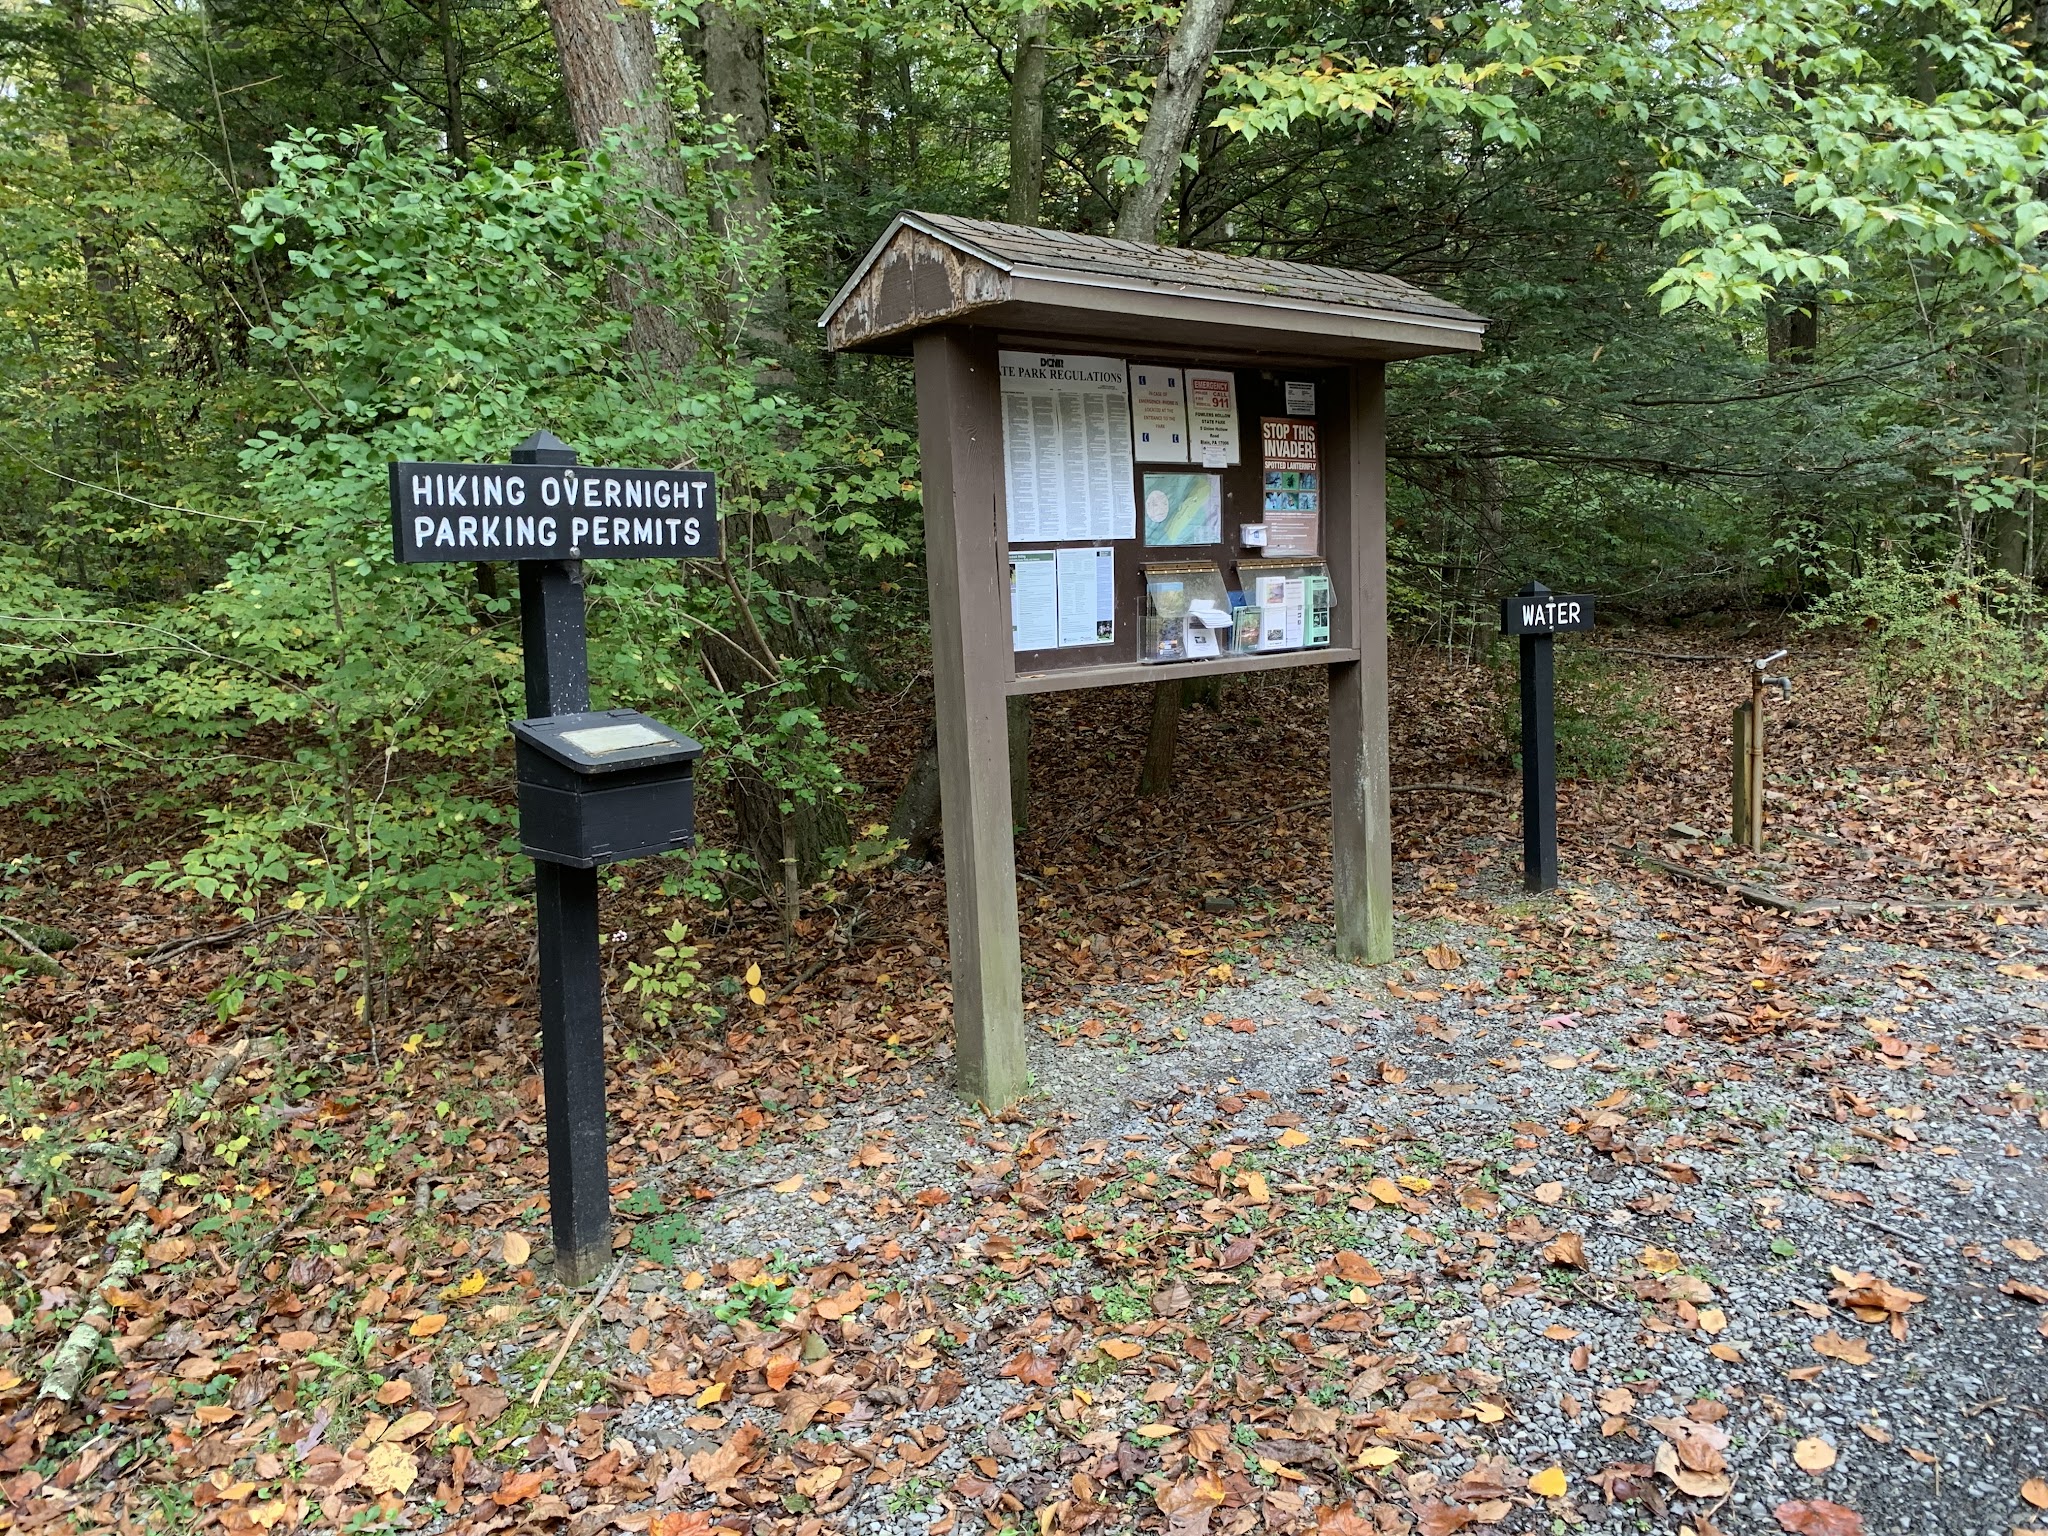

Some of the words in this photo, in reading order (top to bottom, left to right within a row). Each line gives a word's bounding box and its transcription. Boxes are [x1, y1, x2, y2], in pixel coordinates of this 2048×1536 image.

[999, 366, 1015, 377] TE
[1018, 367, 1047, 379] PARK
[1049, 369, 1122, 384] REGULATIONS
[1194, 380, 1228, 391] EMERGENCY
[1212, 397, 1229, 408] 911
[1263, 422, 1290, 440] STOP
[1292, 424, 1316, 441] THIS
[1264, 440, 1317, 459] INVADER!
[1264, 460, 1287, 470] SPOTTED
[1286, 461, 1317, 471] LANTERNFLY
[411, 474, 526, 508] HIKING
[540, 476, 708, 510] OVERNIGHT
[413, 515, 558, 548] PARKING
[571, 516, 701, 547] PERMITS
[1522, 601, 1581, 627] WATER
